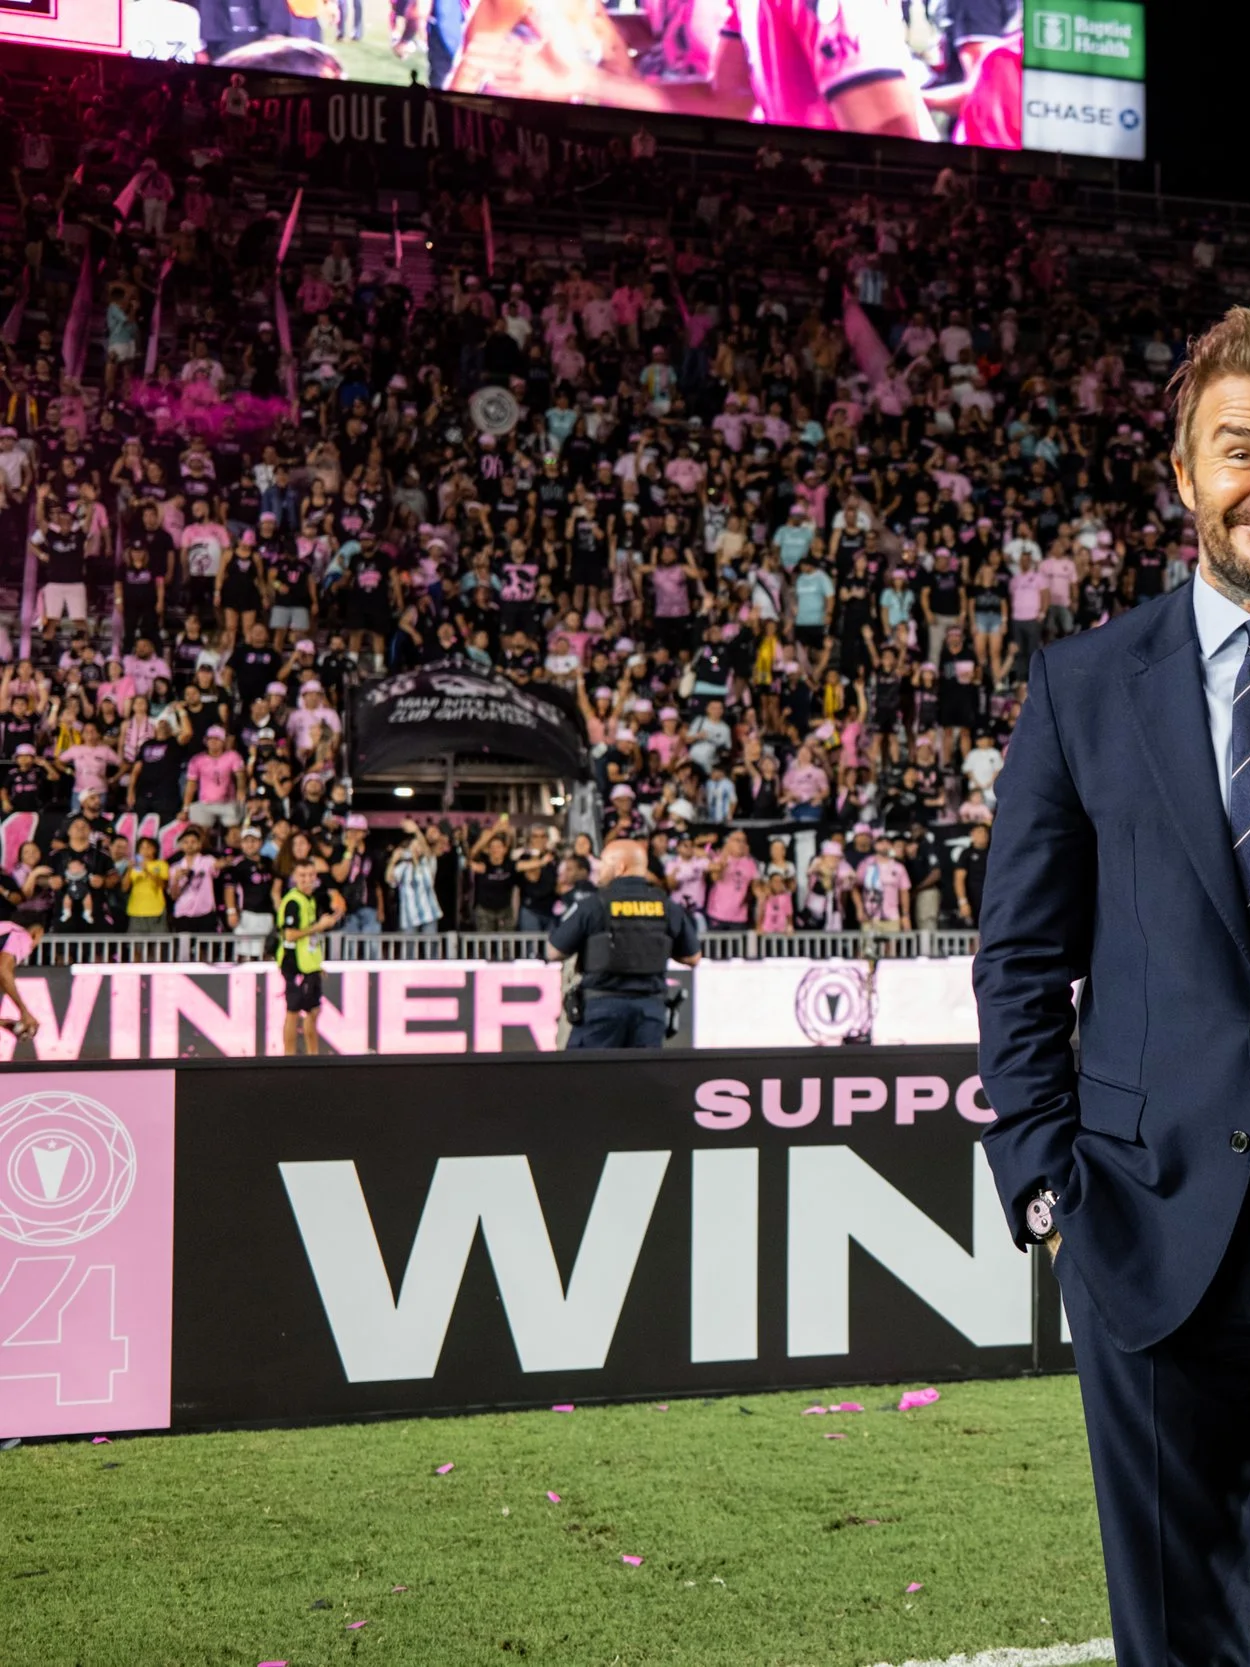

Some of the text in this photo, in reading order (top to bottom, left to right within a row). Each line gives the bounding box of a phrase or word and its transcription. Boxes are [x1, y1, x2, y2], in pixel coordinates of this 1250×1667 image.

[328, 94, 387, 144] QUE
[403, 99, 440, 149] LA
[1026, 100, 1114, 126] CHASE
[610, 901, 665, 917] POLICE
